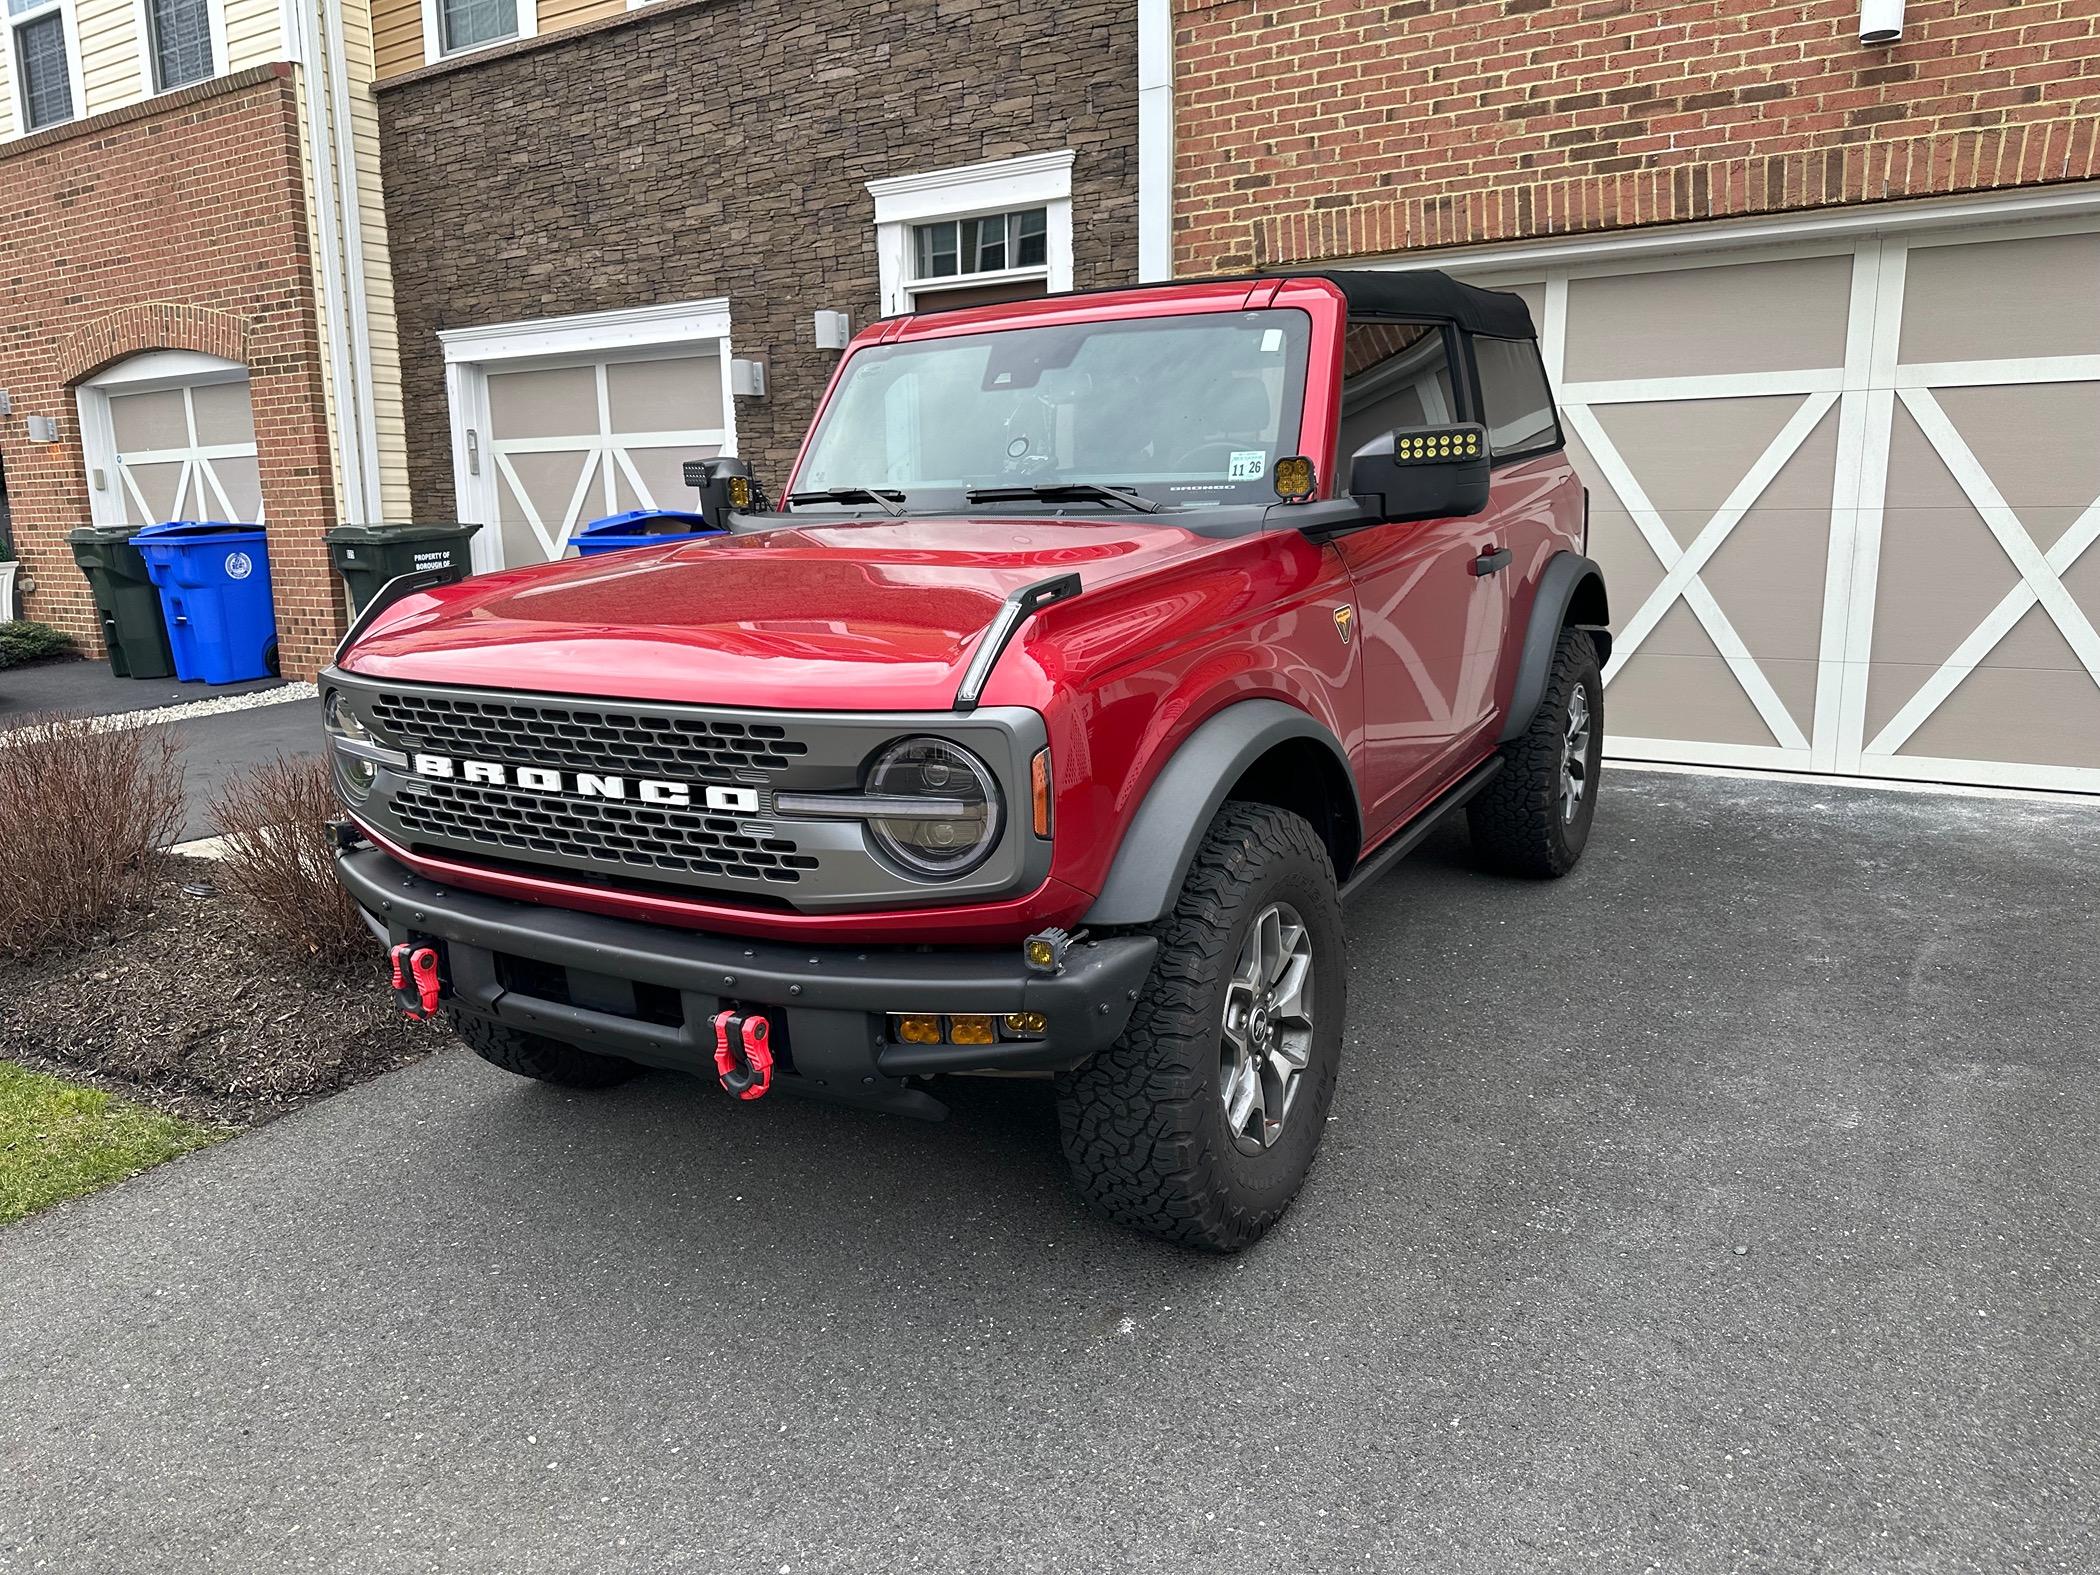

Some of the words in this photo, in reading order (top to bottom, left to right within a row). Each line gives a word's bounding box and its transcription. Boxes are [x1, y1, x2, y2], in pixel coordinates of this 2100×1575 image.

[1232, 464, 1244, 476] 11
[1249, 461, 1261, 473] 26
[414, 552, 442, 561] PROPERTY
[416, 561, 442, 570] BOROUGH
[415, 753, 759, 812] BRONCO
